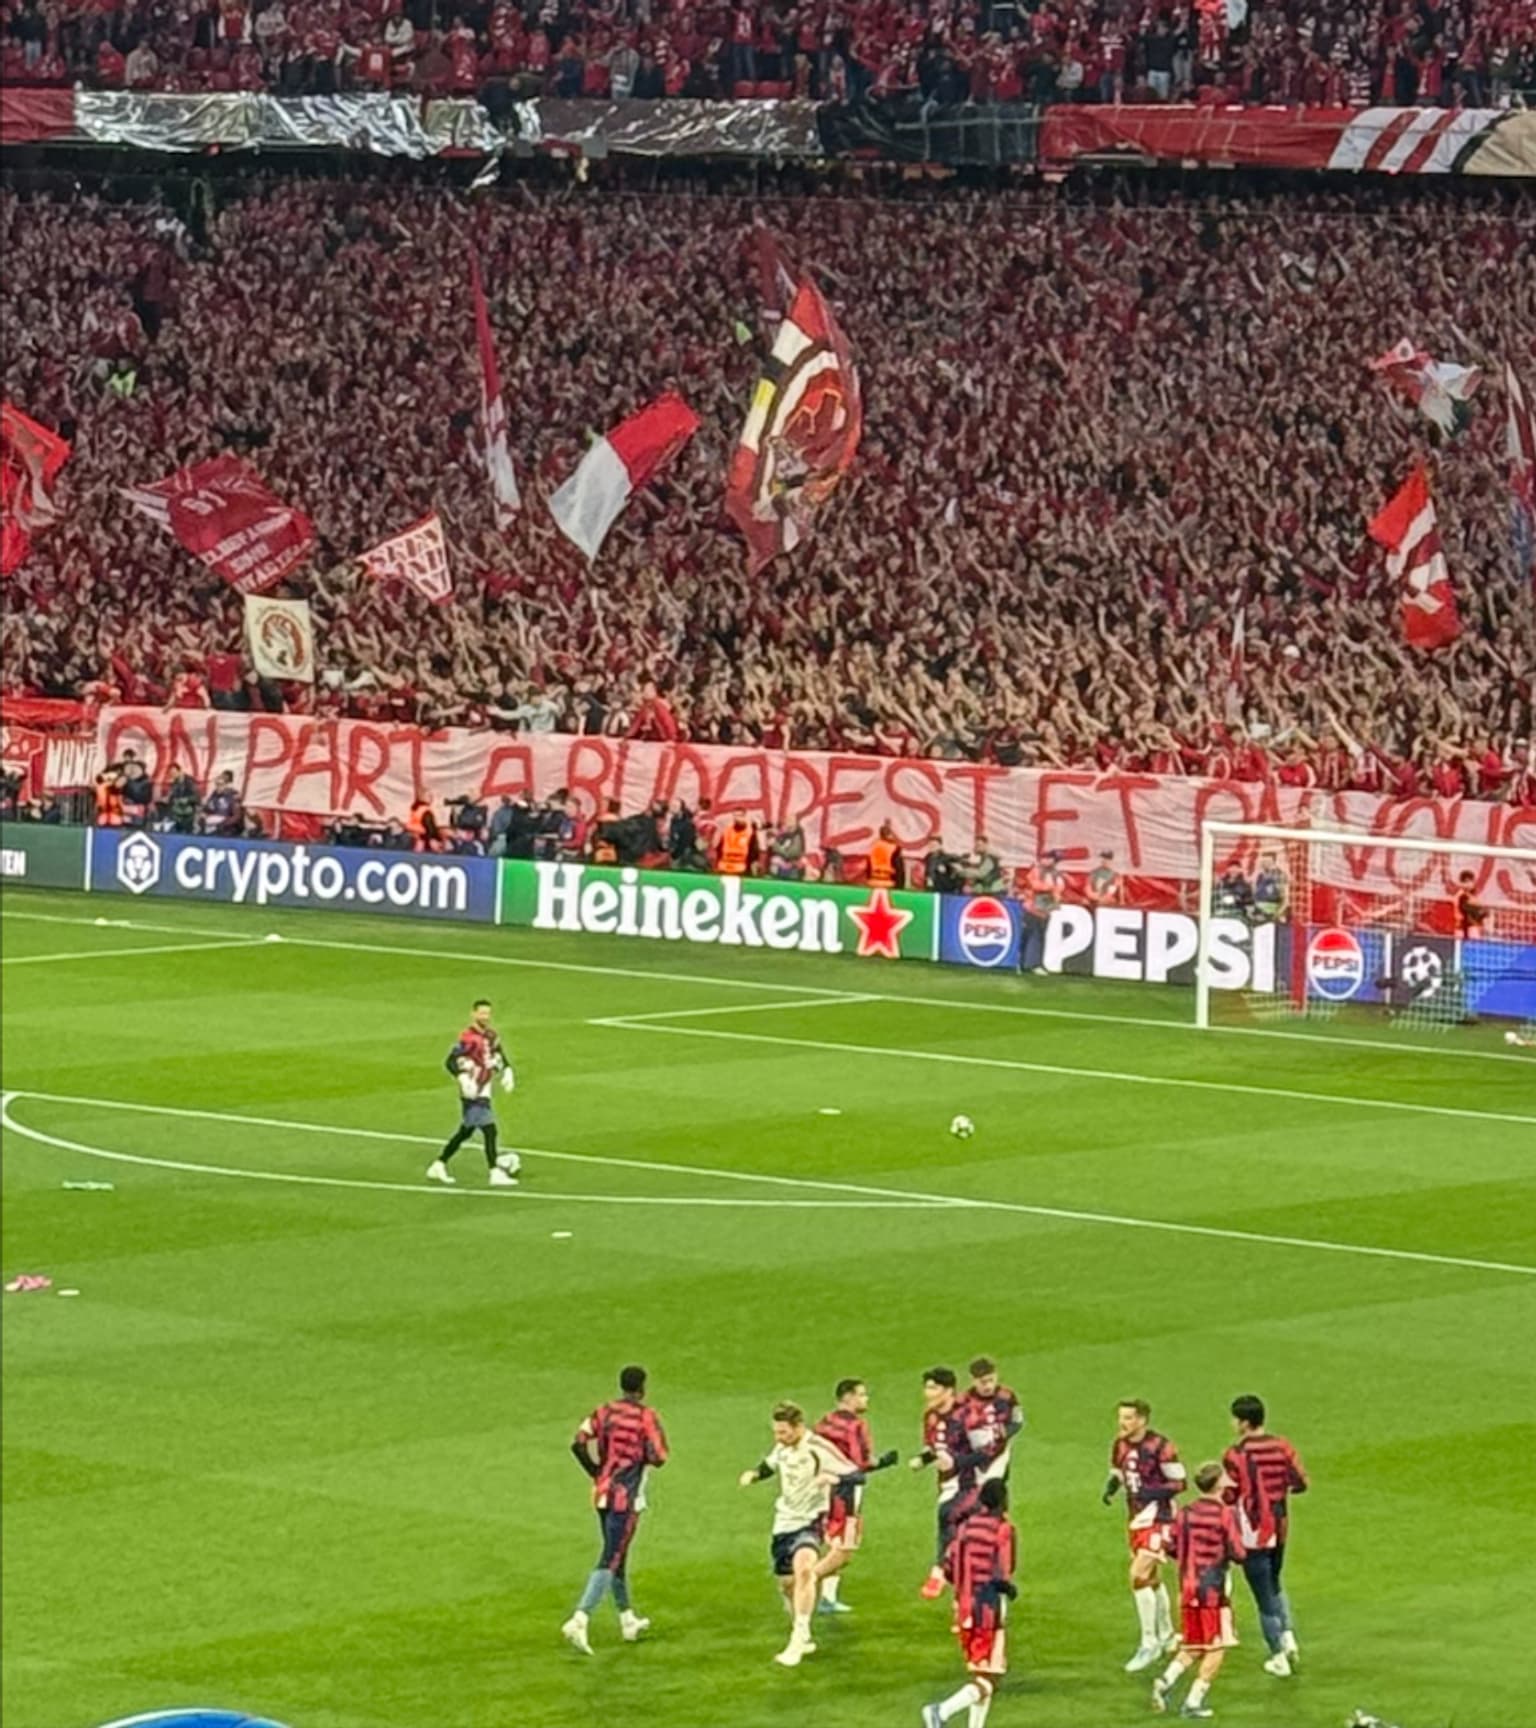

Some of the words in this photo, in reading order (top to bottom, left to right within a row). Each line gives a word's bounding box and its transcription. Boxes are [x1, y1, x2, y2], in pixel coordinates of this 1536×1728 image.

[106, 713, 218, 799] ON
[240, 716, 449, 815] PART
[567, 737, 1010, 852] BUDAPEST
[1029, 772, 1160, 868] ET
[176, 845, 467, 910] crypto.com
[532, 862, 843, 953] Heineken
[963, 922, 1008, 940] PEPSI
[1042, 904, 1276, 993] PEPSI
[1312, 955, 1359, 972] PEPSI
